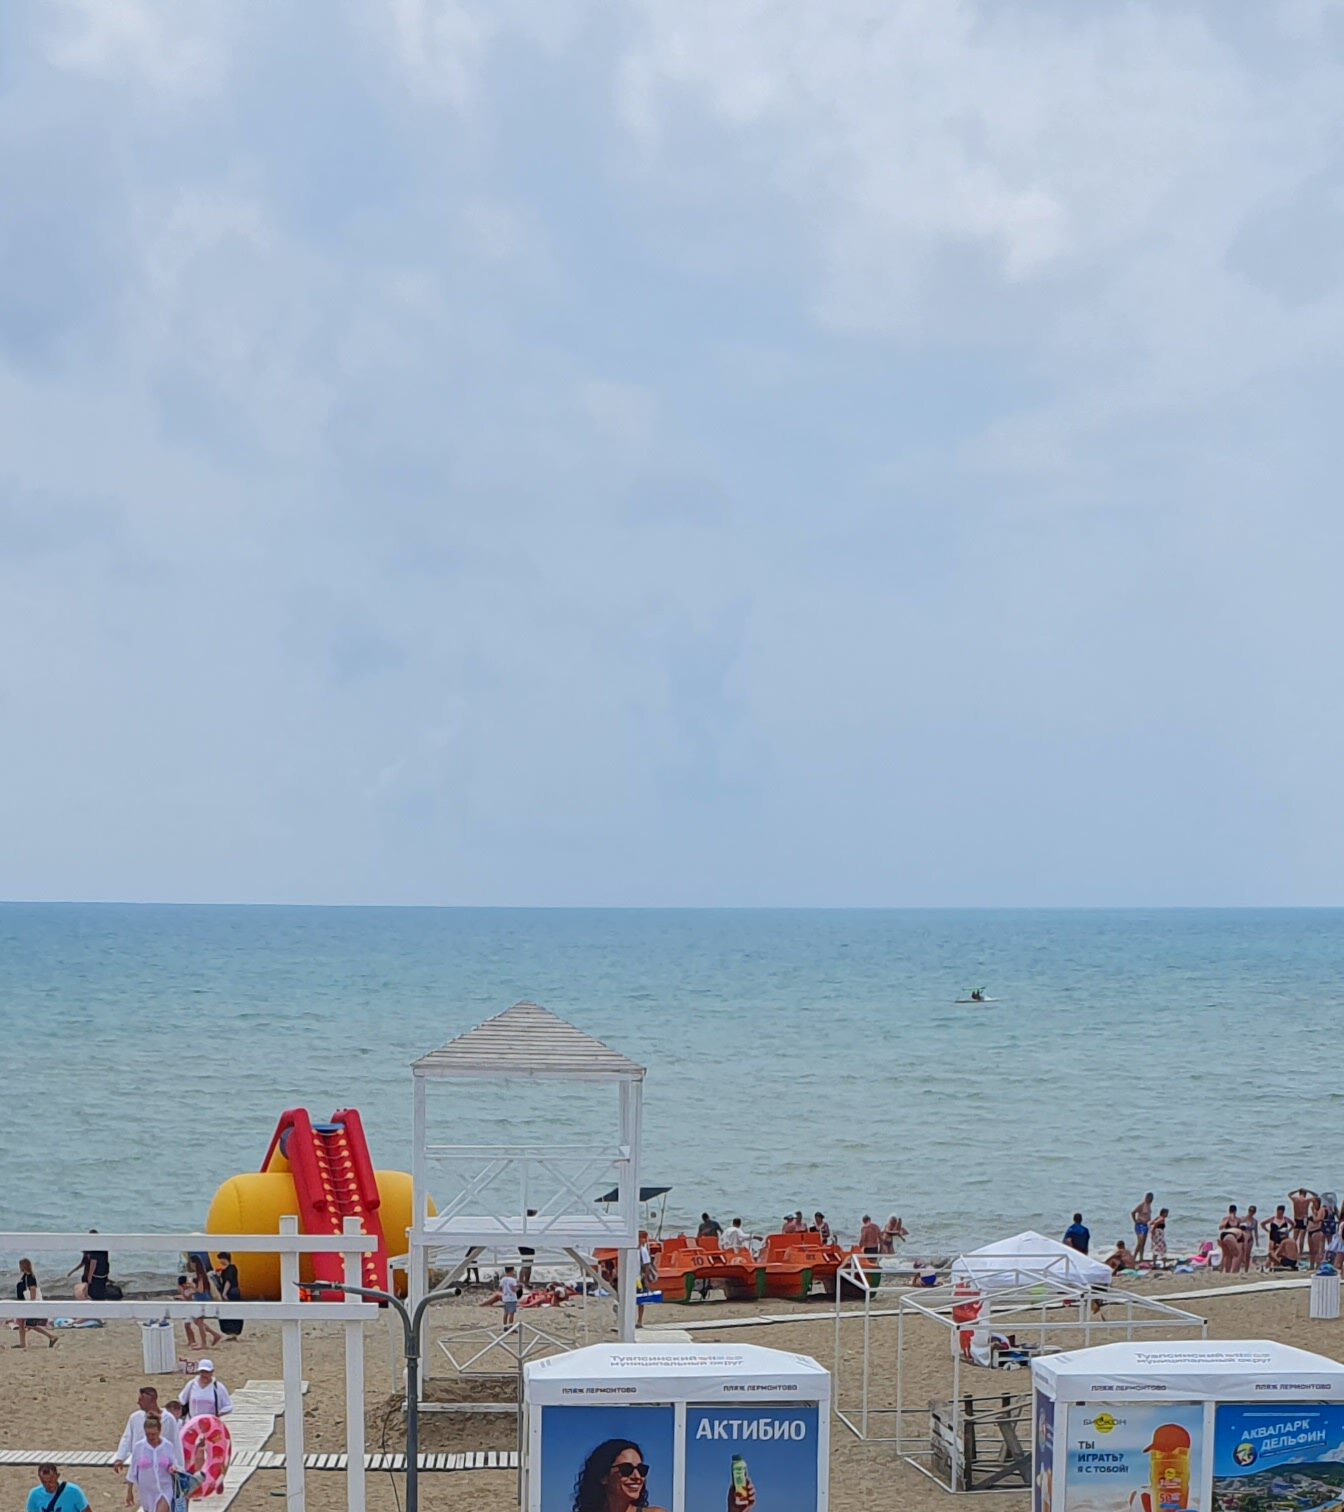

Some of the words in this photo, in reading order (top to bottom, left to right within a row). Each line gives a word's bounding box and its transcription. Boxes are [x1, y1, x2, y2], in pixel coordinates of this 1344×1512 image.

[696, 1418, 806, 1441] АКТИБИО
[1241, 1419, 1311, 1441] АКВАПАРК
[1078, 1441, 1095, 1449] ТЫ
[1260, 1429, 1327, 1452] ДЕЛЬФИН
[1078, 1453, 1125, 1463] ИГРАТЬ?
[1094, 1464, 1129, 1473] ТОБОЙ!
